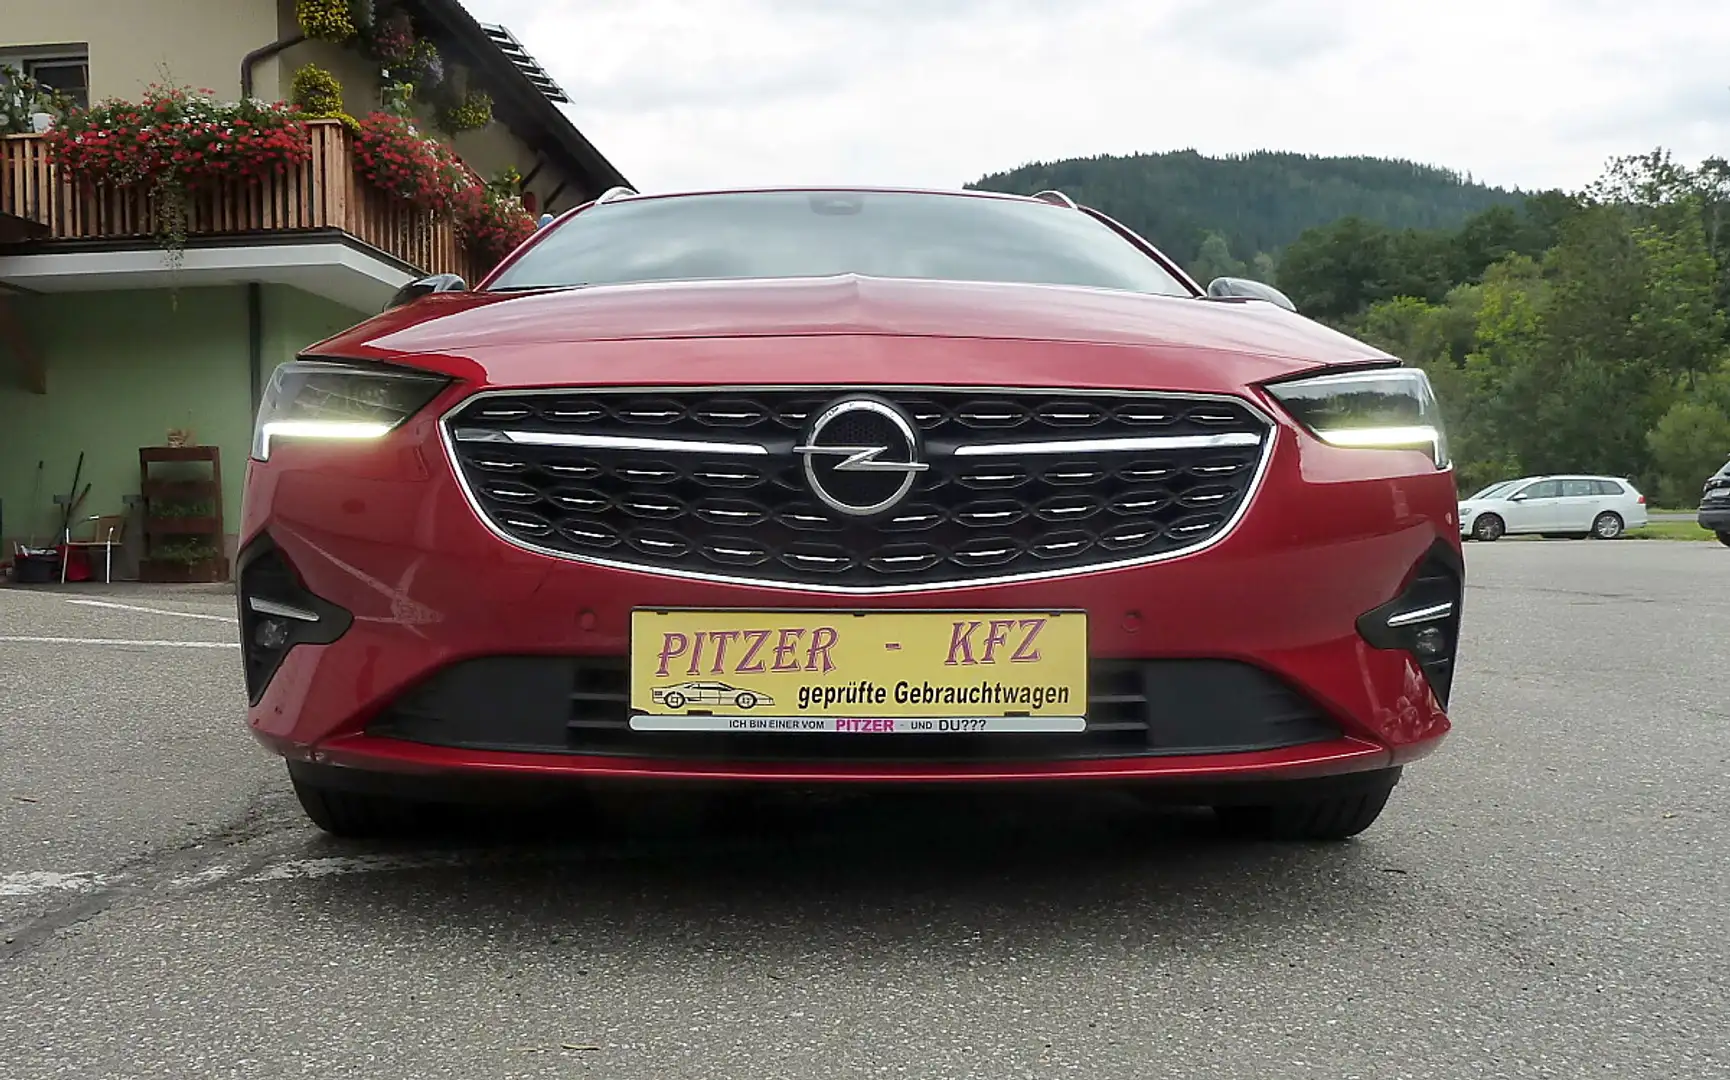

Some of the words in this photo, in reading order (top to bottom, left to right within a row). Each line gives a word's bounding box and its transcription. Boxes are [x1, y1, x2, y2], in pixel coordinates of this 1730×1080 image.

[655, 626, 839, 677] PITZER
[944, 618, 1047, 666] KFZ
[798, 681, 886, 709] geprüfte
[894, 681, 1069, 708] Gebrauchtwagen
[729, 719, 747, 729] ICH
[749, 719, 767, 729] BIN
[768, 719, 800, 730] EINER
[801, 720, 825, 730] VOM
[836, 719, 894, 732] PITZER
[911, 721, 933, 730] UND
[939, 719, 986, 731] DU???
